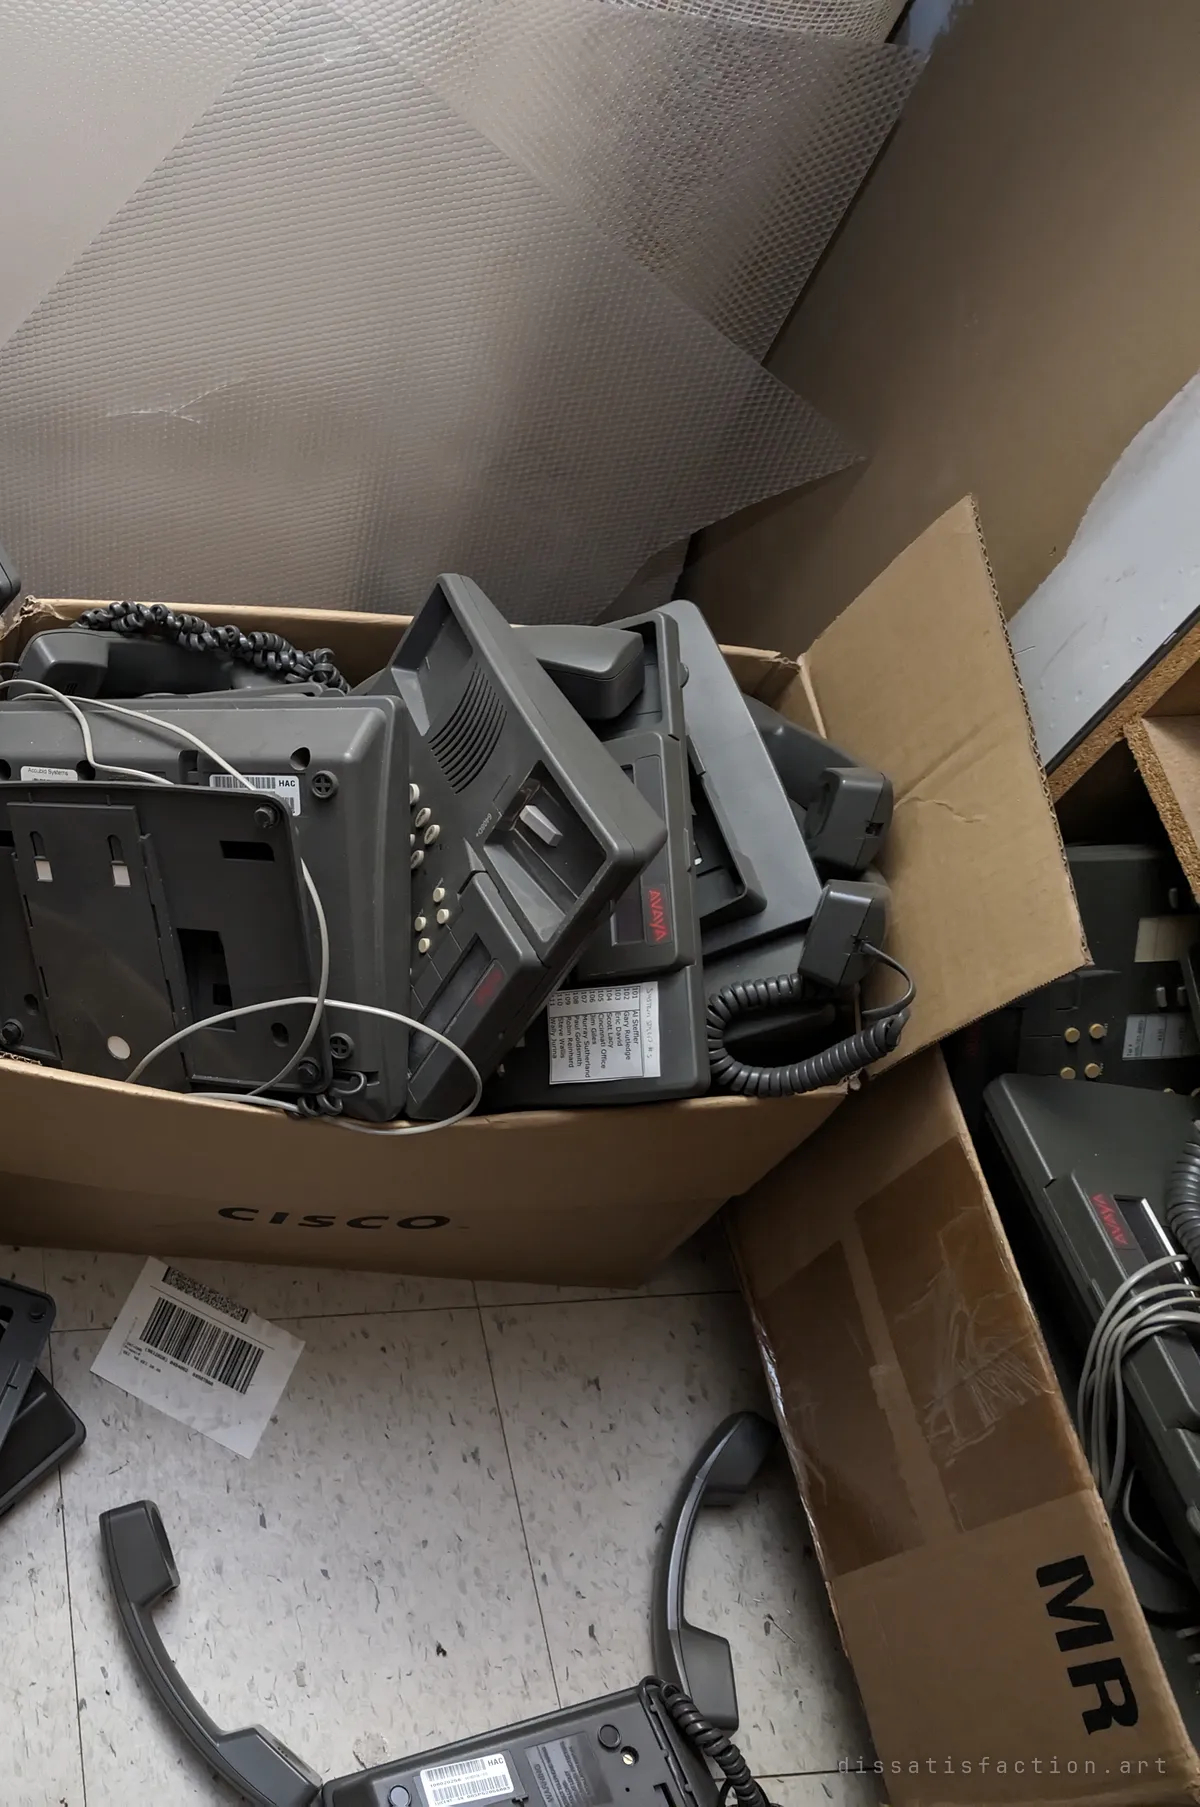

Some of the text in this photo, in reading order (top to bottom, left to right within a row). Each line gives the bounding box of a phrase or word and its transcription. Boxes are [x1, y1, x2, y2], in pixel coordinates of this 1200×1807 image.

[648, 889, 667, 942] AVAYA
[623, 1029, 631, 1060] Rutledge
[218, 1207, 451, 1230] CISCO
[1092, 1193, 1129, 1245] AVAYA
[1036, 1555, 1139, 1735] MR
[486, 1757, 504, 1766] HAC
[533, 1763, 553, 1802] WARNING
